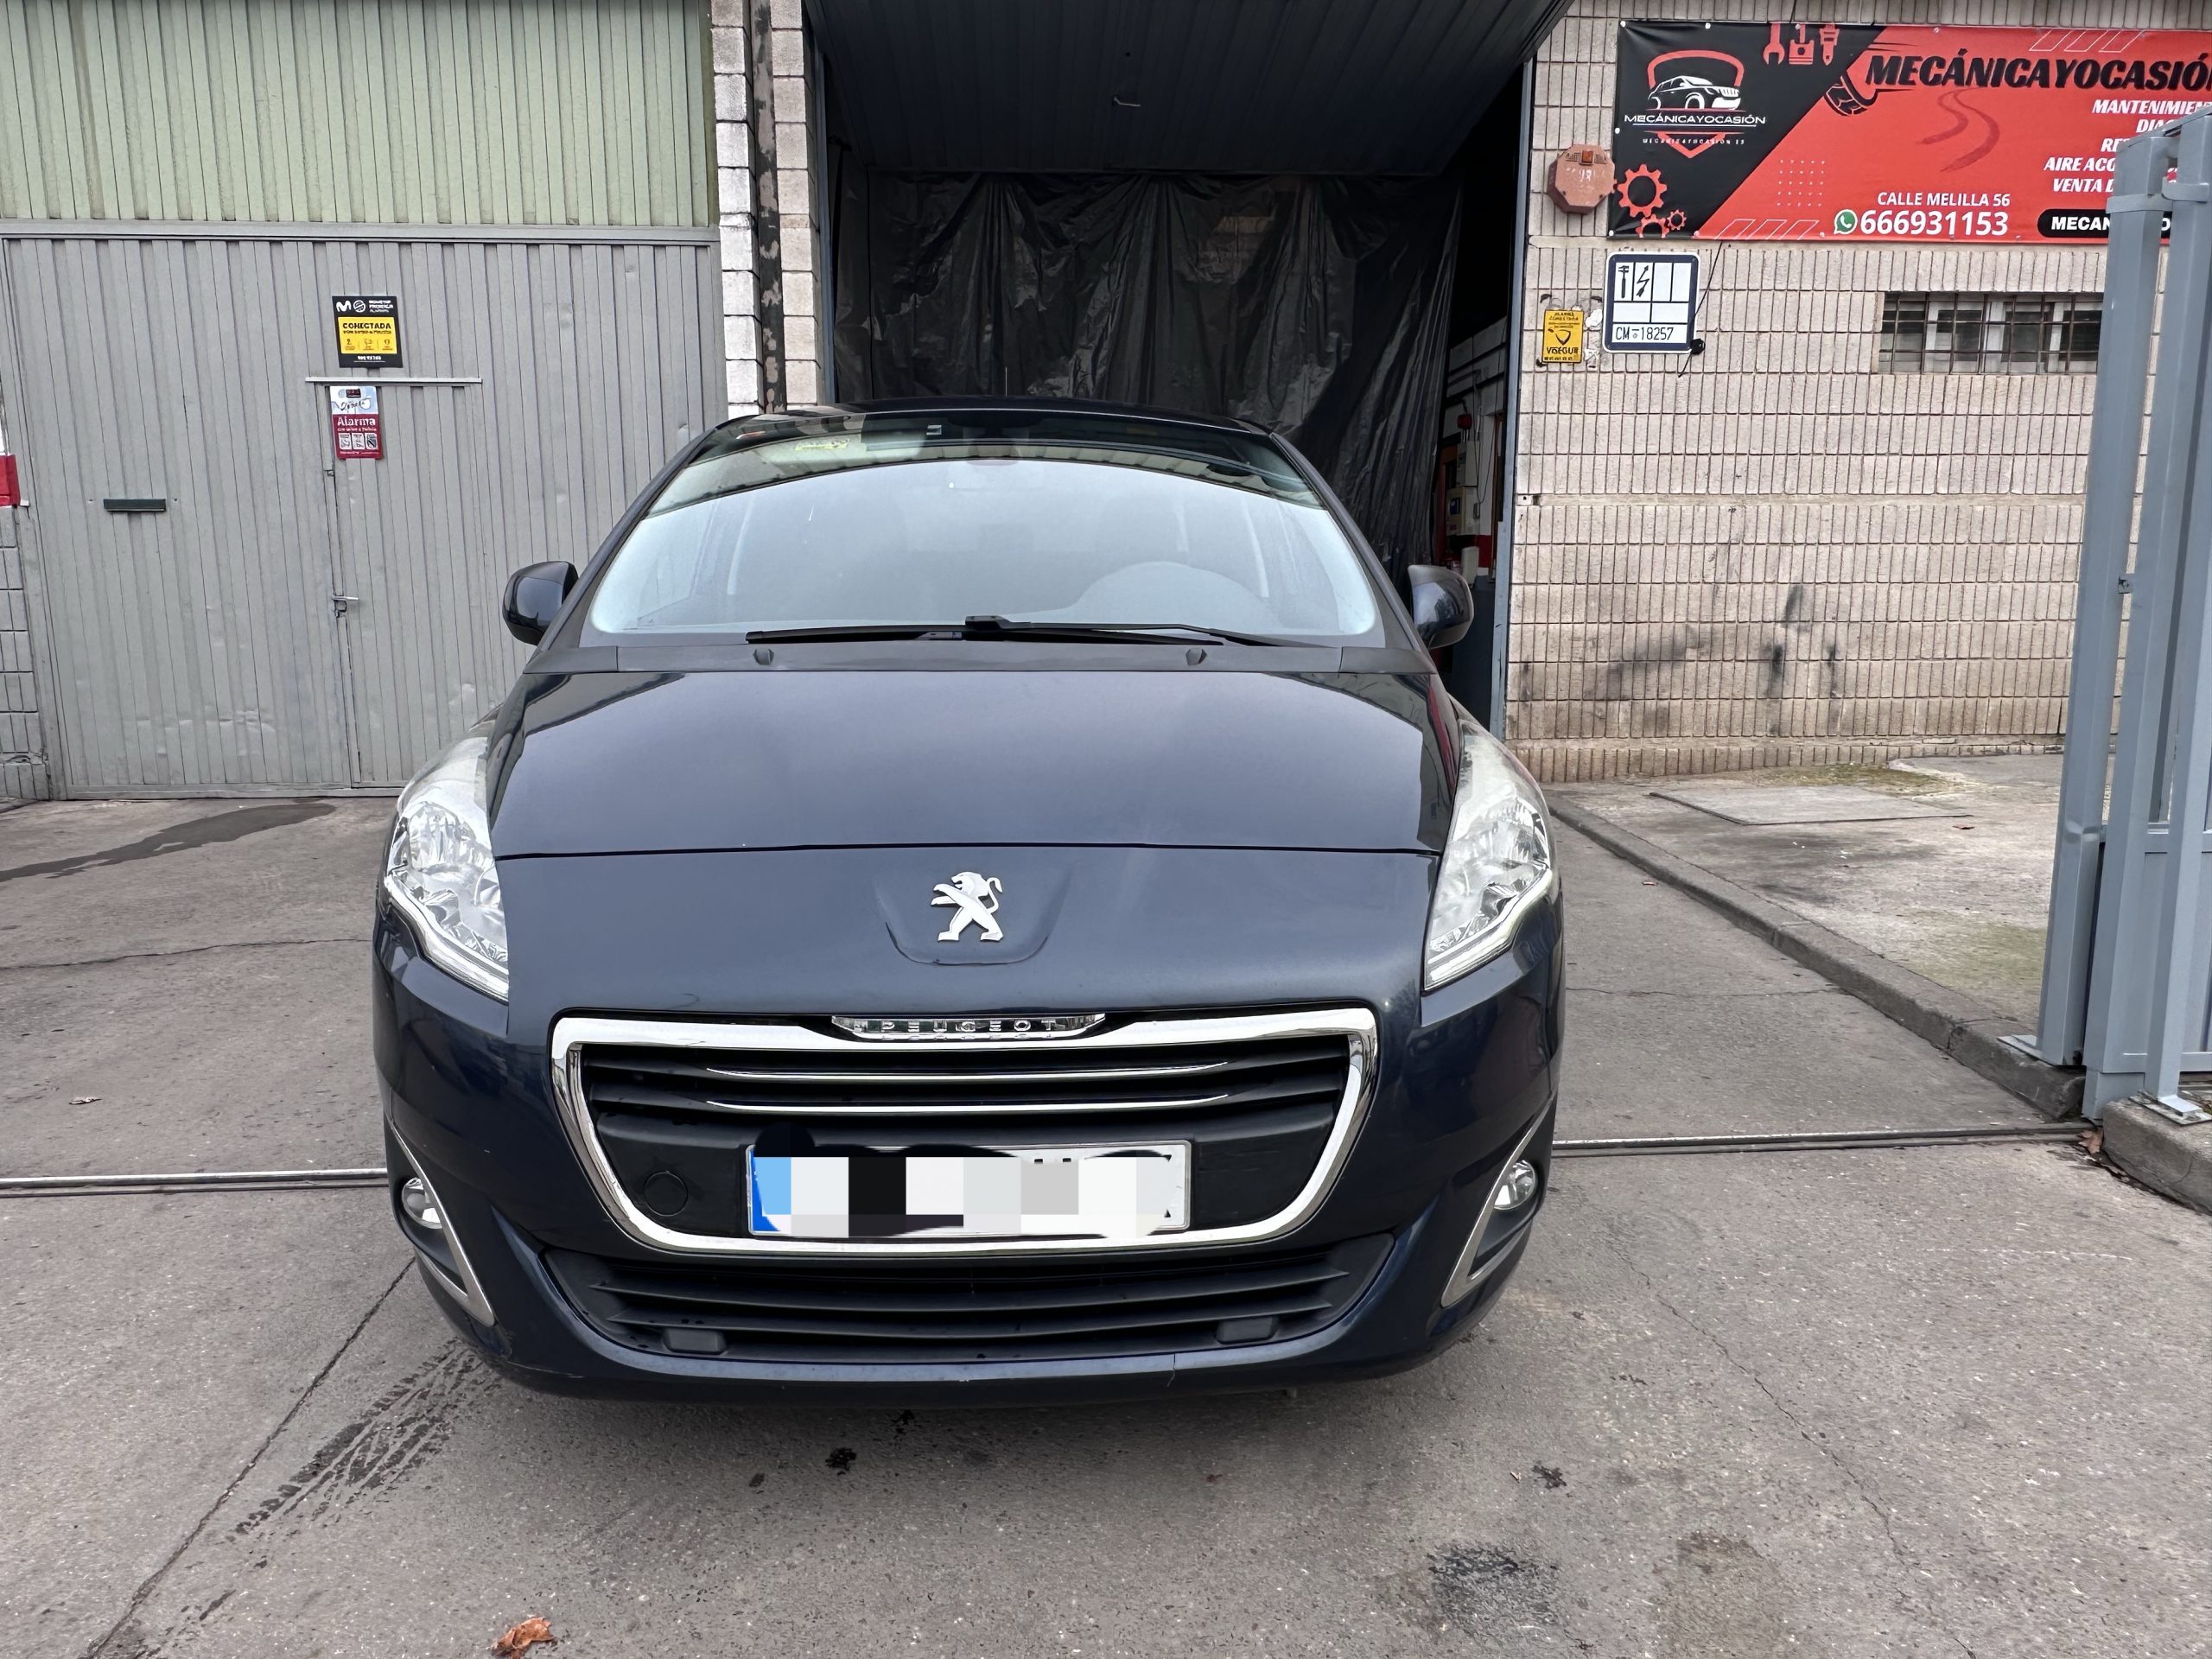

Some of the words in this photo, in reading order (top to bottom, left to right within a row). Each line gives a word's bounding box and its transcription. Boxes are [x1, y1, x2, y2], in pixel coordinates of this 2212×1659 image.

[1866, 48, 2212, 92] MECÁNICAYOCASIÓ
[2092, 99, 2212, 115] MANTENIMIE
[1624, 112, 1765, 124] MECÁNICAYOCASIÓN
[2136, 118, 2176, 133] DIA
[2044, 157, 2083, 171] AIRE
[2053, 178, 2102, 192] VENTA
[1878, 192, 1923, 206] CALLE
[1926, 193, 1989, 207] MELILLA
[1993, 194, 2011, 207] 56
[1860, 209, 2009, 236] 666931153
[2051, 217, 2111, 231] MECAN
[337, 416, 376, 426] Alarma
[880, 1019, 1056, 1033] PEUGEOT
